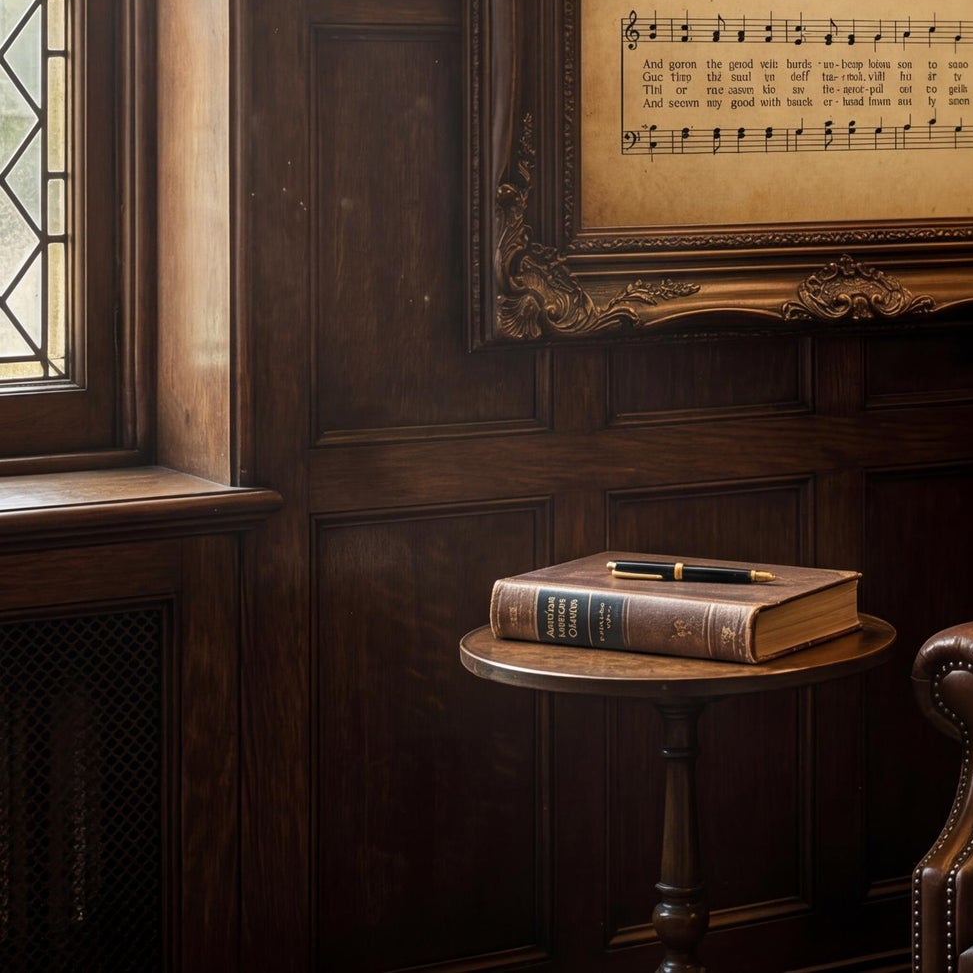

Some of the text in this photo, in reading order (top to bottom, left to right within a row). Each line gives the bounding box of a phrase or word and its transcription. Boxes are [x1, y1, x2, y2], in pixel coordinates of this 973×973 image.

[643, 59, 663, 69] And
[707, 59, 722, 69] the
[643, 98, 663, 108] And
[731, 97, 755, 109] good
